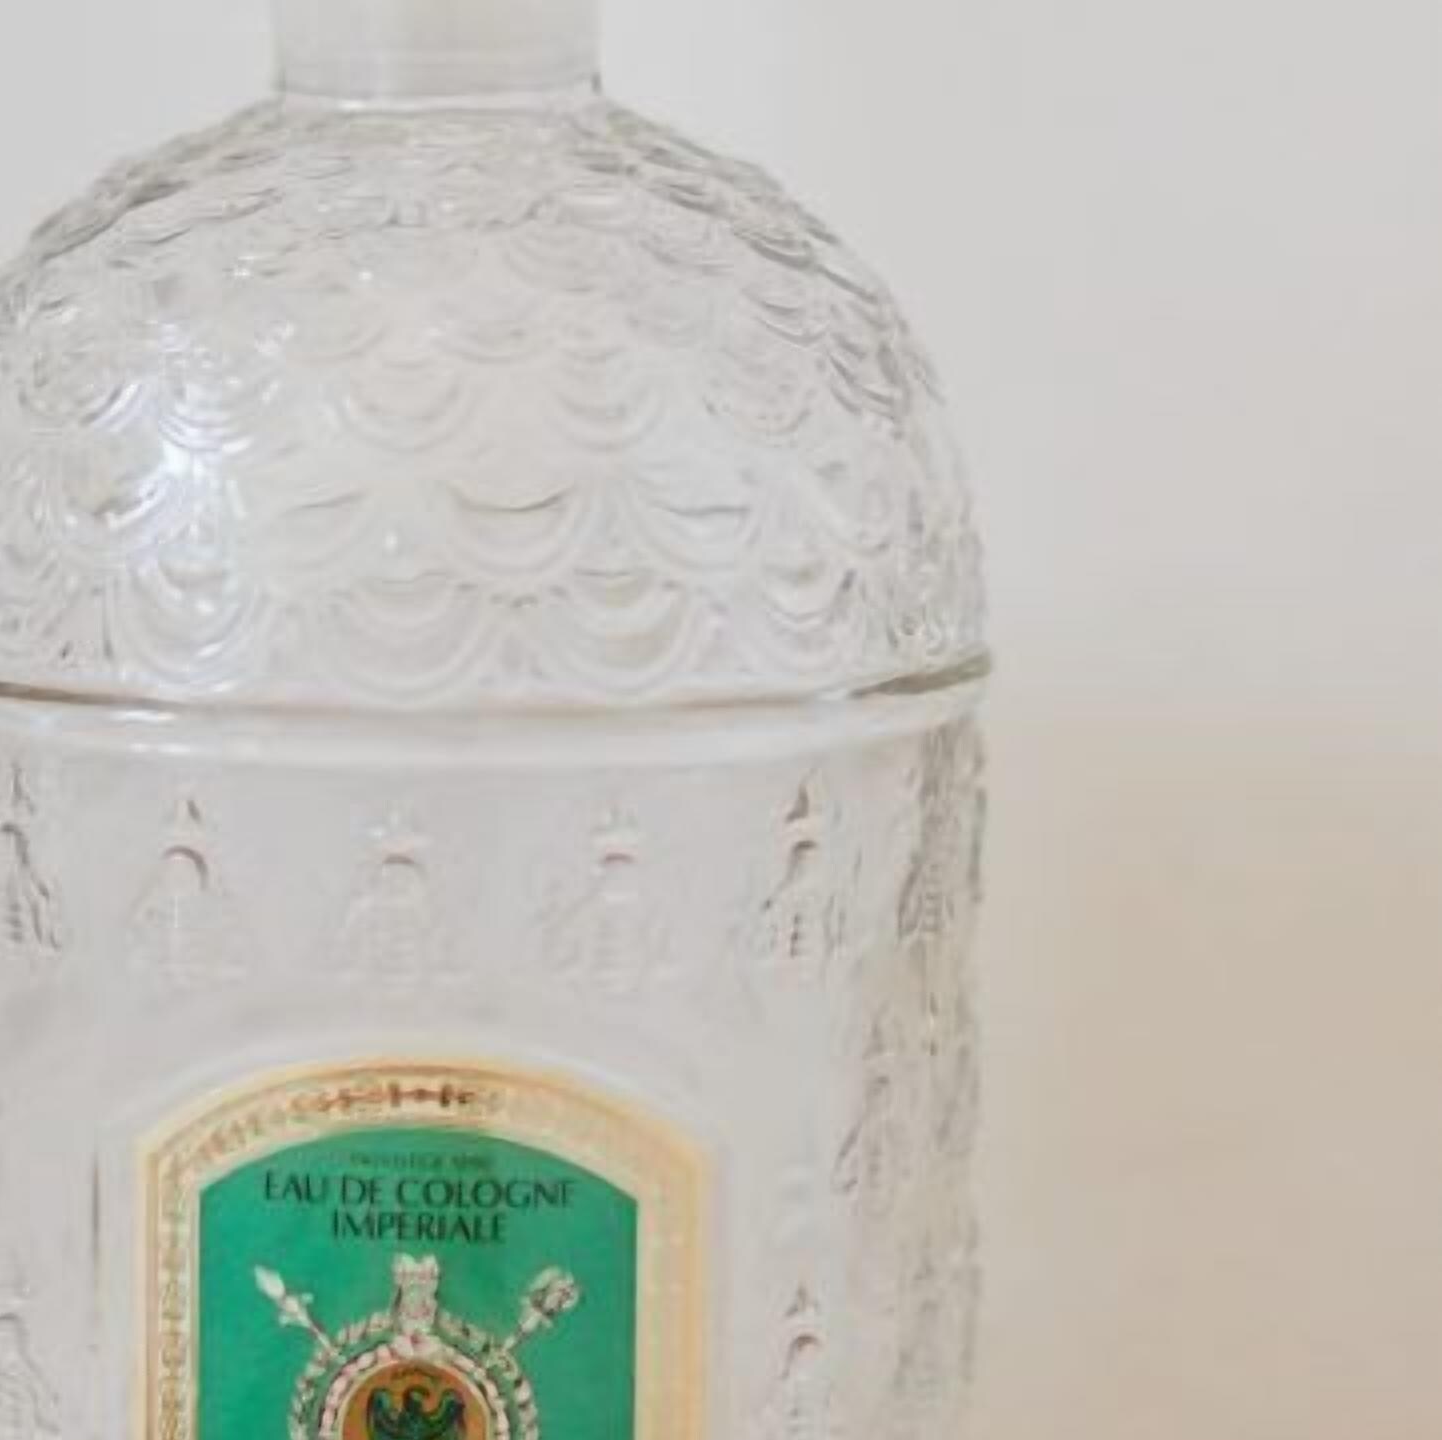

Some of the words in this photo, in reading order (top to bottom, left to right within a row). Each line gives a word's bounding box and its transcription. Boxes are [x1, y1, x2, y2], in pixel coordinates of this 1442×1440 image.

[263, 1169, 329, 1204] EAU
[341, 1173, 385, 1206] DE
[395, 1176, 576, 1210] COLOGNE
[332, 1208, 508, 1244] IMPERIALE
